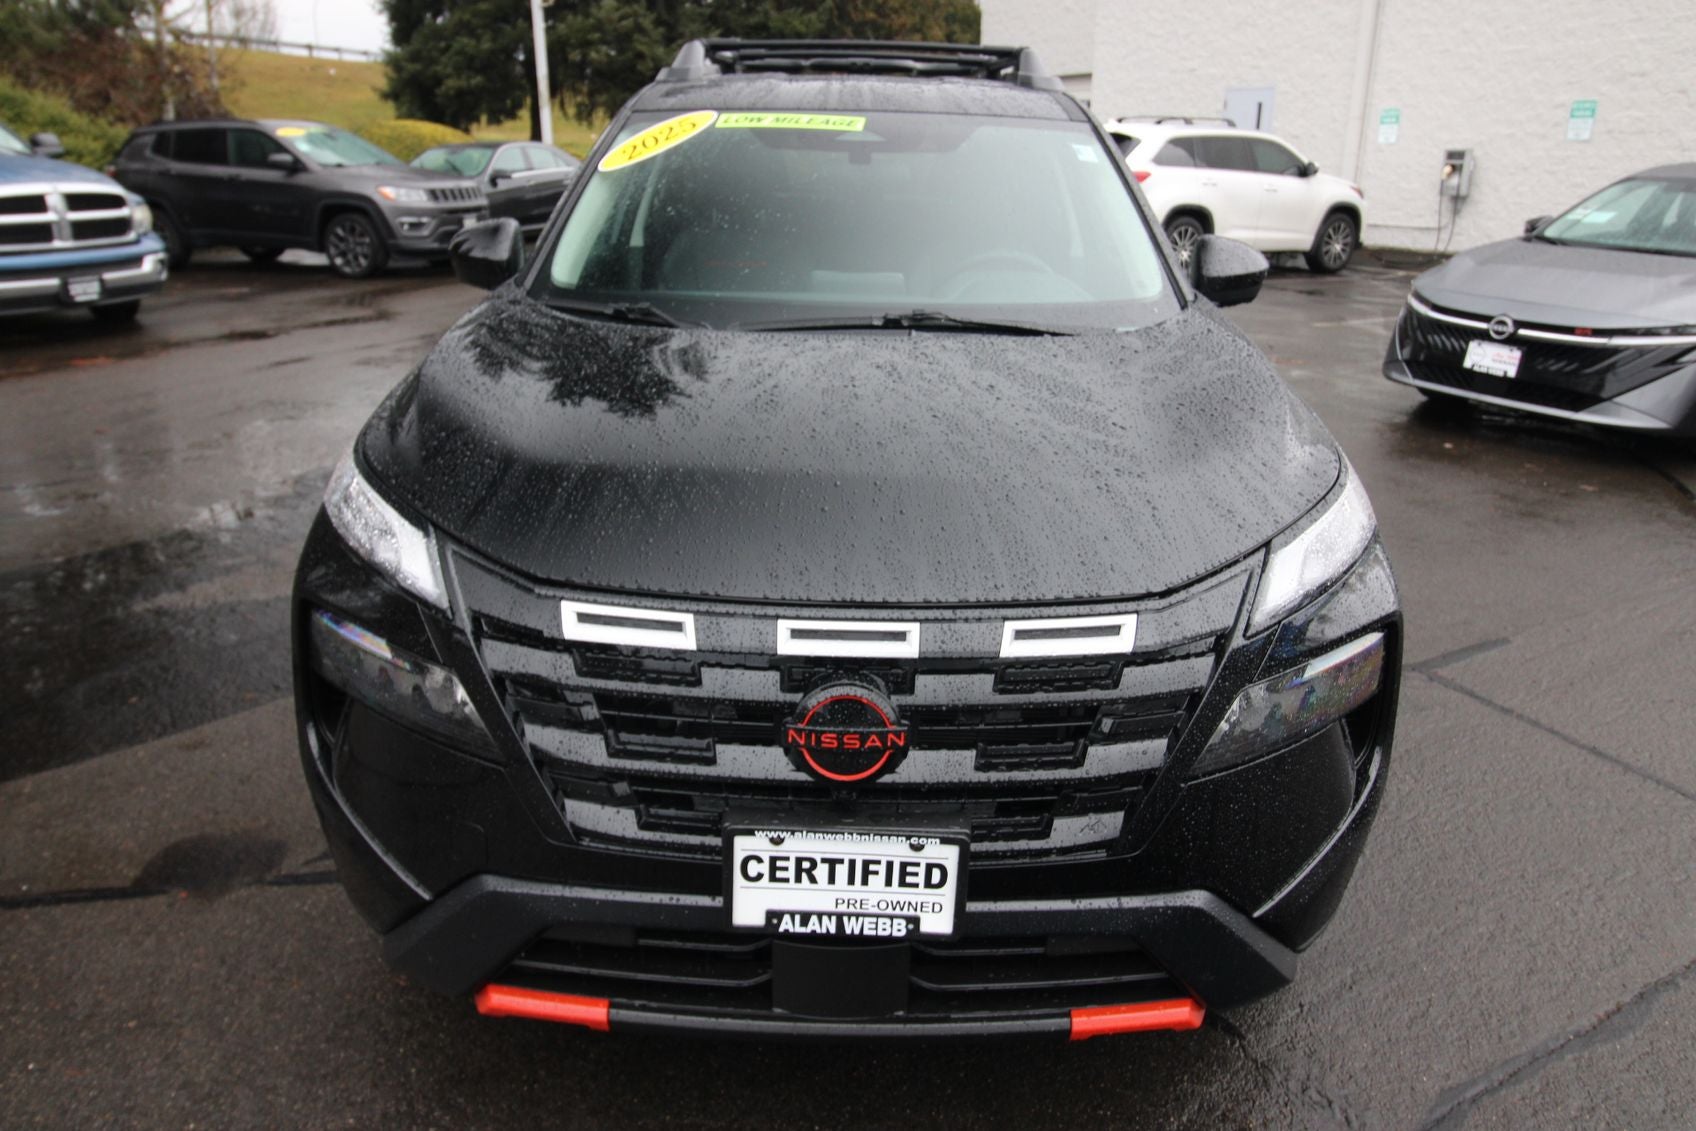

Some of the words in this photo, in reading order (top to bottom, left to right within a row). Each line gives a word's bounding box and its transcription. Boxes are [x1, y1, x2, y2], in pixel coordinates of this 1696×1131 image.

[722, 115, 765, 125] LOW
[768, 115, 859, 128] MILEAGE
[622, 117, 697, 161] 2025
[787, 728, 906, 749] NISSAN
[754, 829, 941, 846] www.alanwebbnissan.com
[740, 854, 948, 890] CERTIFIED
[834, 897, 943, 914] PRE-OWNED
[778, 913, 837, 935] ALAN
[842, 916, 908, 938] WEBB
